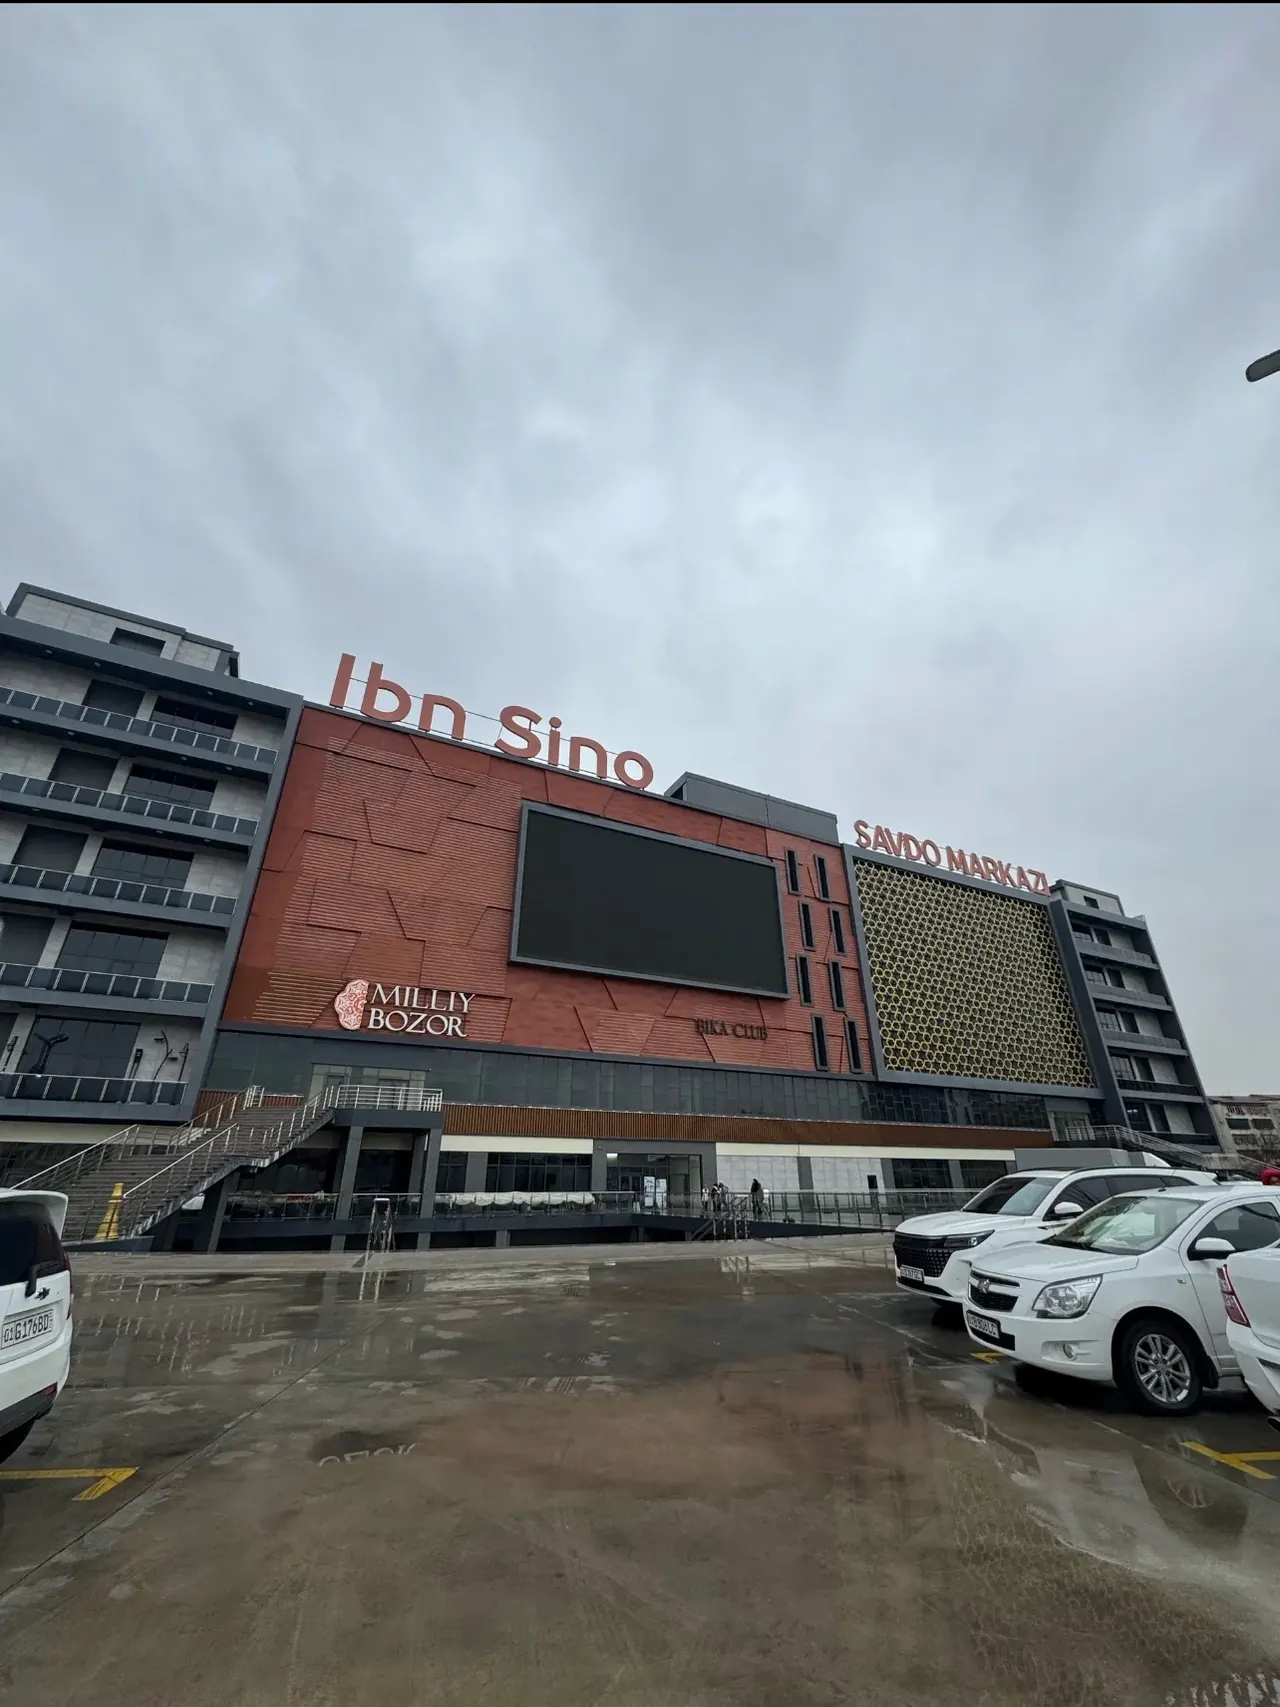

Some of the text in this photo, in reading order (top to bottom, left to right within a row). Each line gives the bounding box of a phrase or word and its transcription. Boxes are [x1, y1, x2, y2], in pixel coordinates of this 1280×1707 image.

[329, 652, 654, 789] Ibn Sino
[853, 819, 1051, 896] SAVDO MARKAZI
[370, 983, 476, 1014] MILLIY
[367, 1007, 468, 1038] BOZOR
[732, 1022, 768, 1041] CLUB
